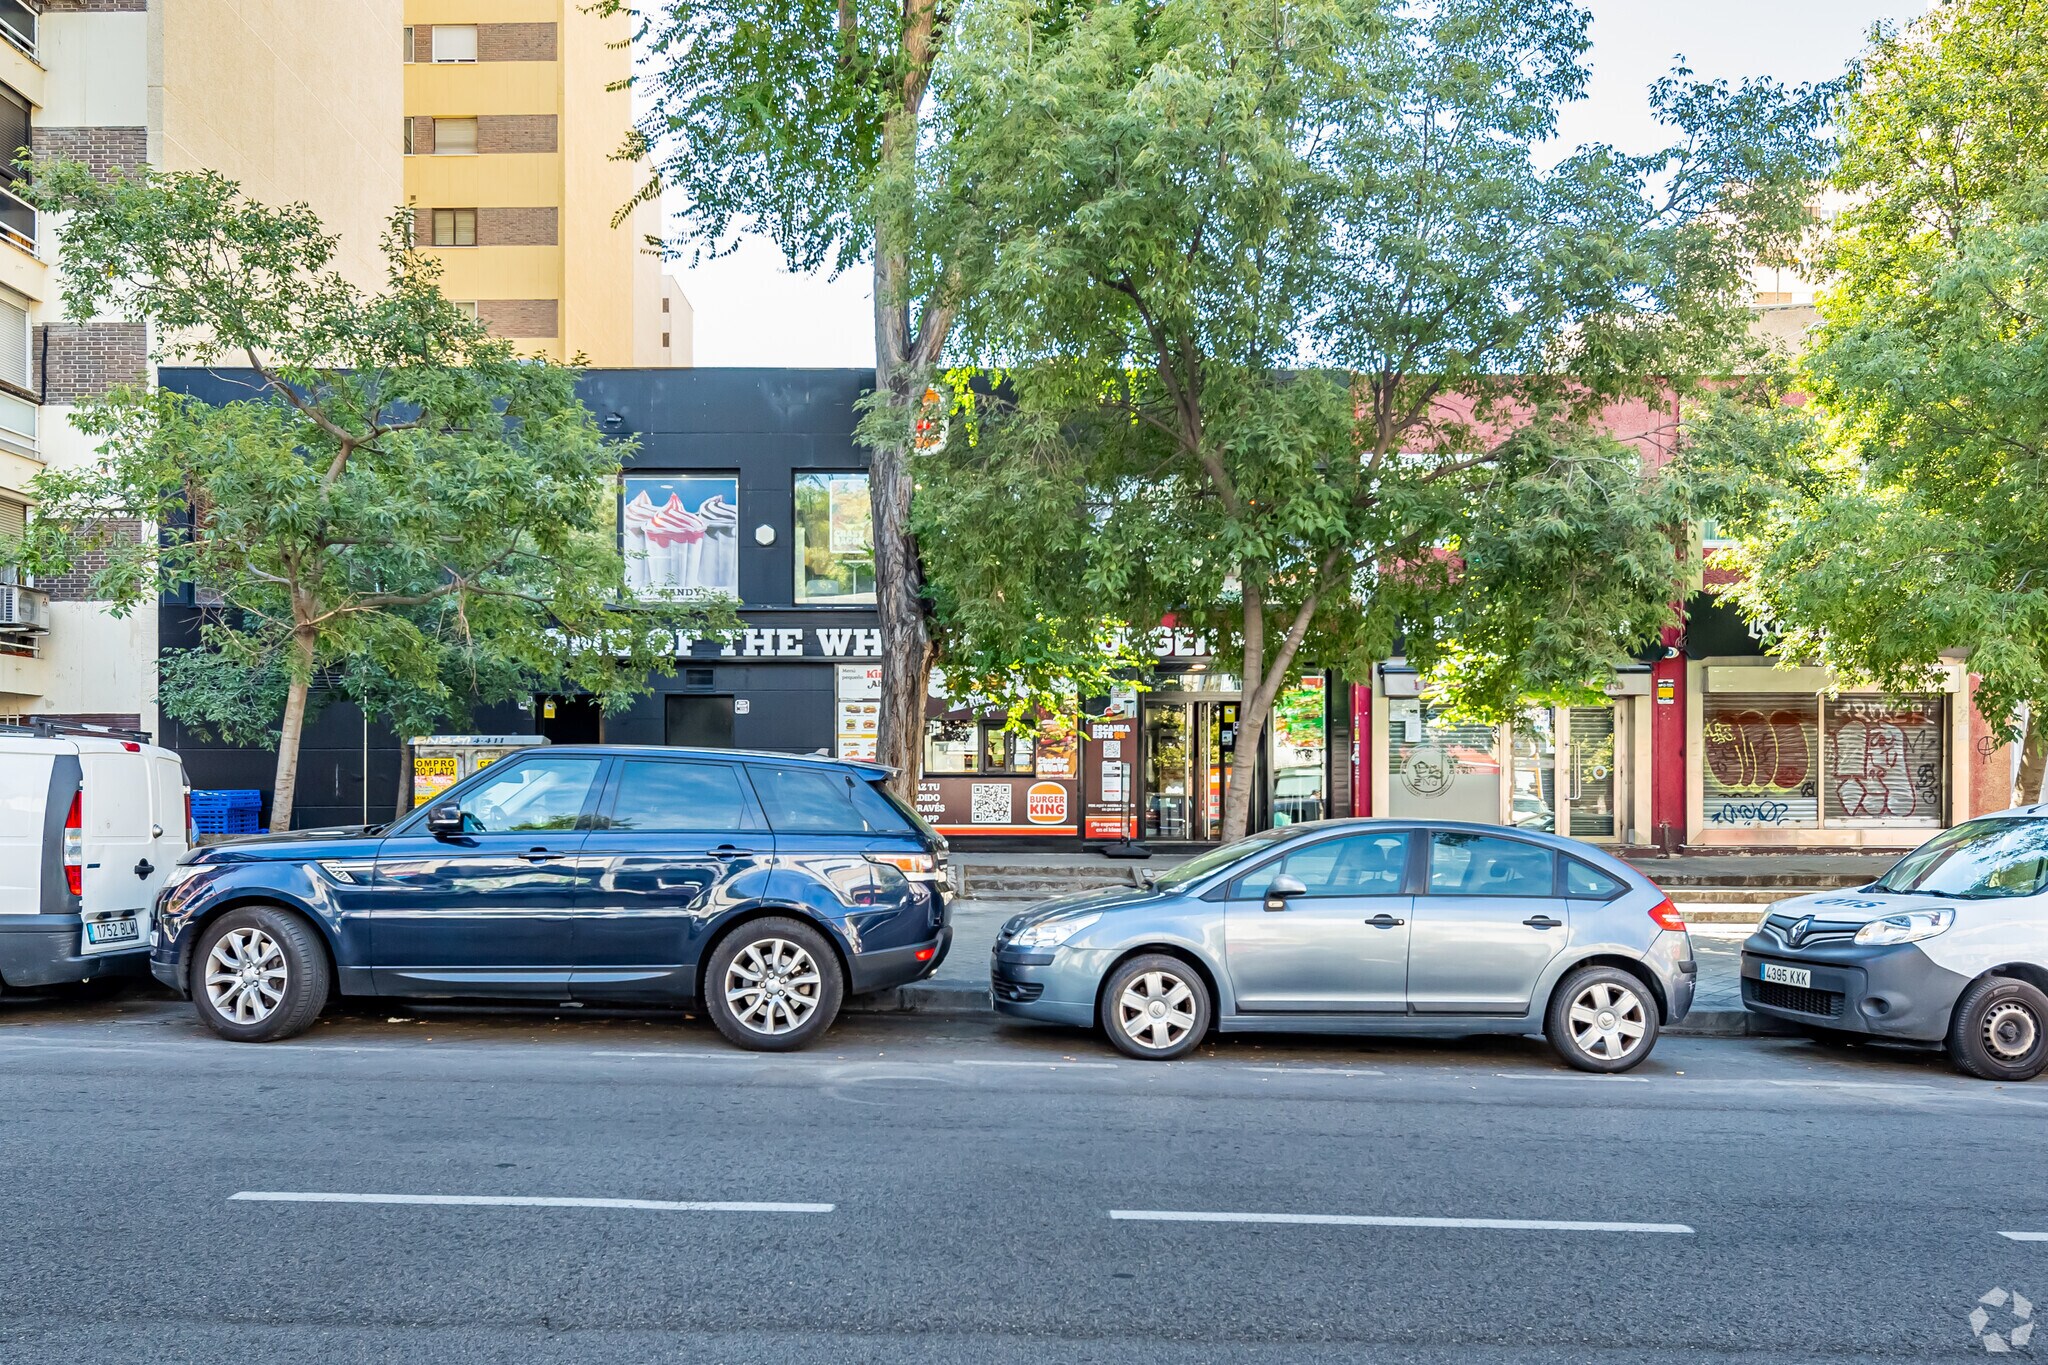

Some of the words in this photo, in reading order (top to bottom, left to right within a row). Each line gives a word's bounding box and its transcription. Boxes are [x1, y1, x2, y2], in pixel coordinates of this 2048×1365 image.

[719, 627, 804, 657] THE
[816, 627, 882, 657] WH
[415, 759, 455, 767] OMPRO
[917, 783, 927, 791] AZ
[928, 783, 940, 791] TU
[1030, 795, 1065, 804] BURGER
[915, 802, 945, 812] RAVÉS
[1030, 804, 1065, 815] KING
[96, 923, 117, 939] 1752
[121, 921, 135, 935] BLM
[1766, 967, 1788, 983] 4395
[1789, 969, 1807, 986] KXK
